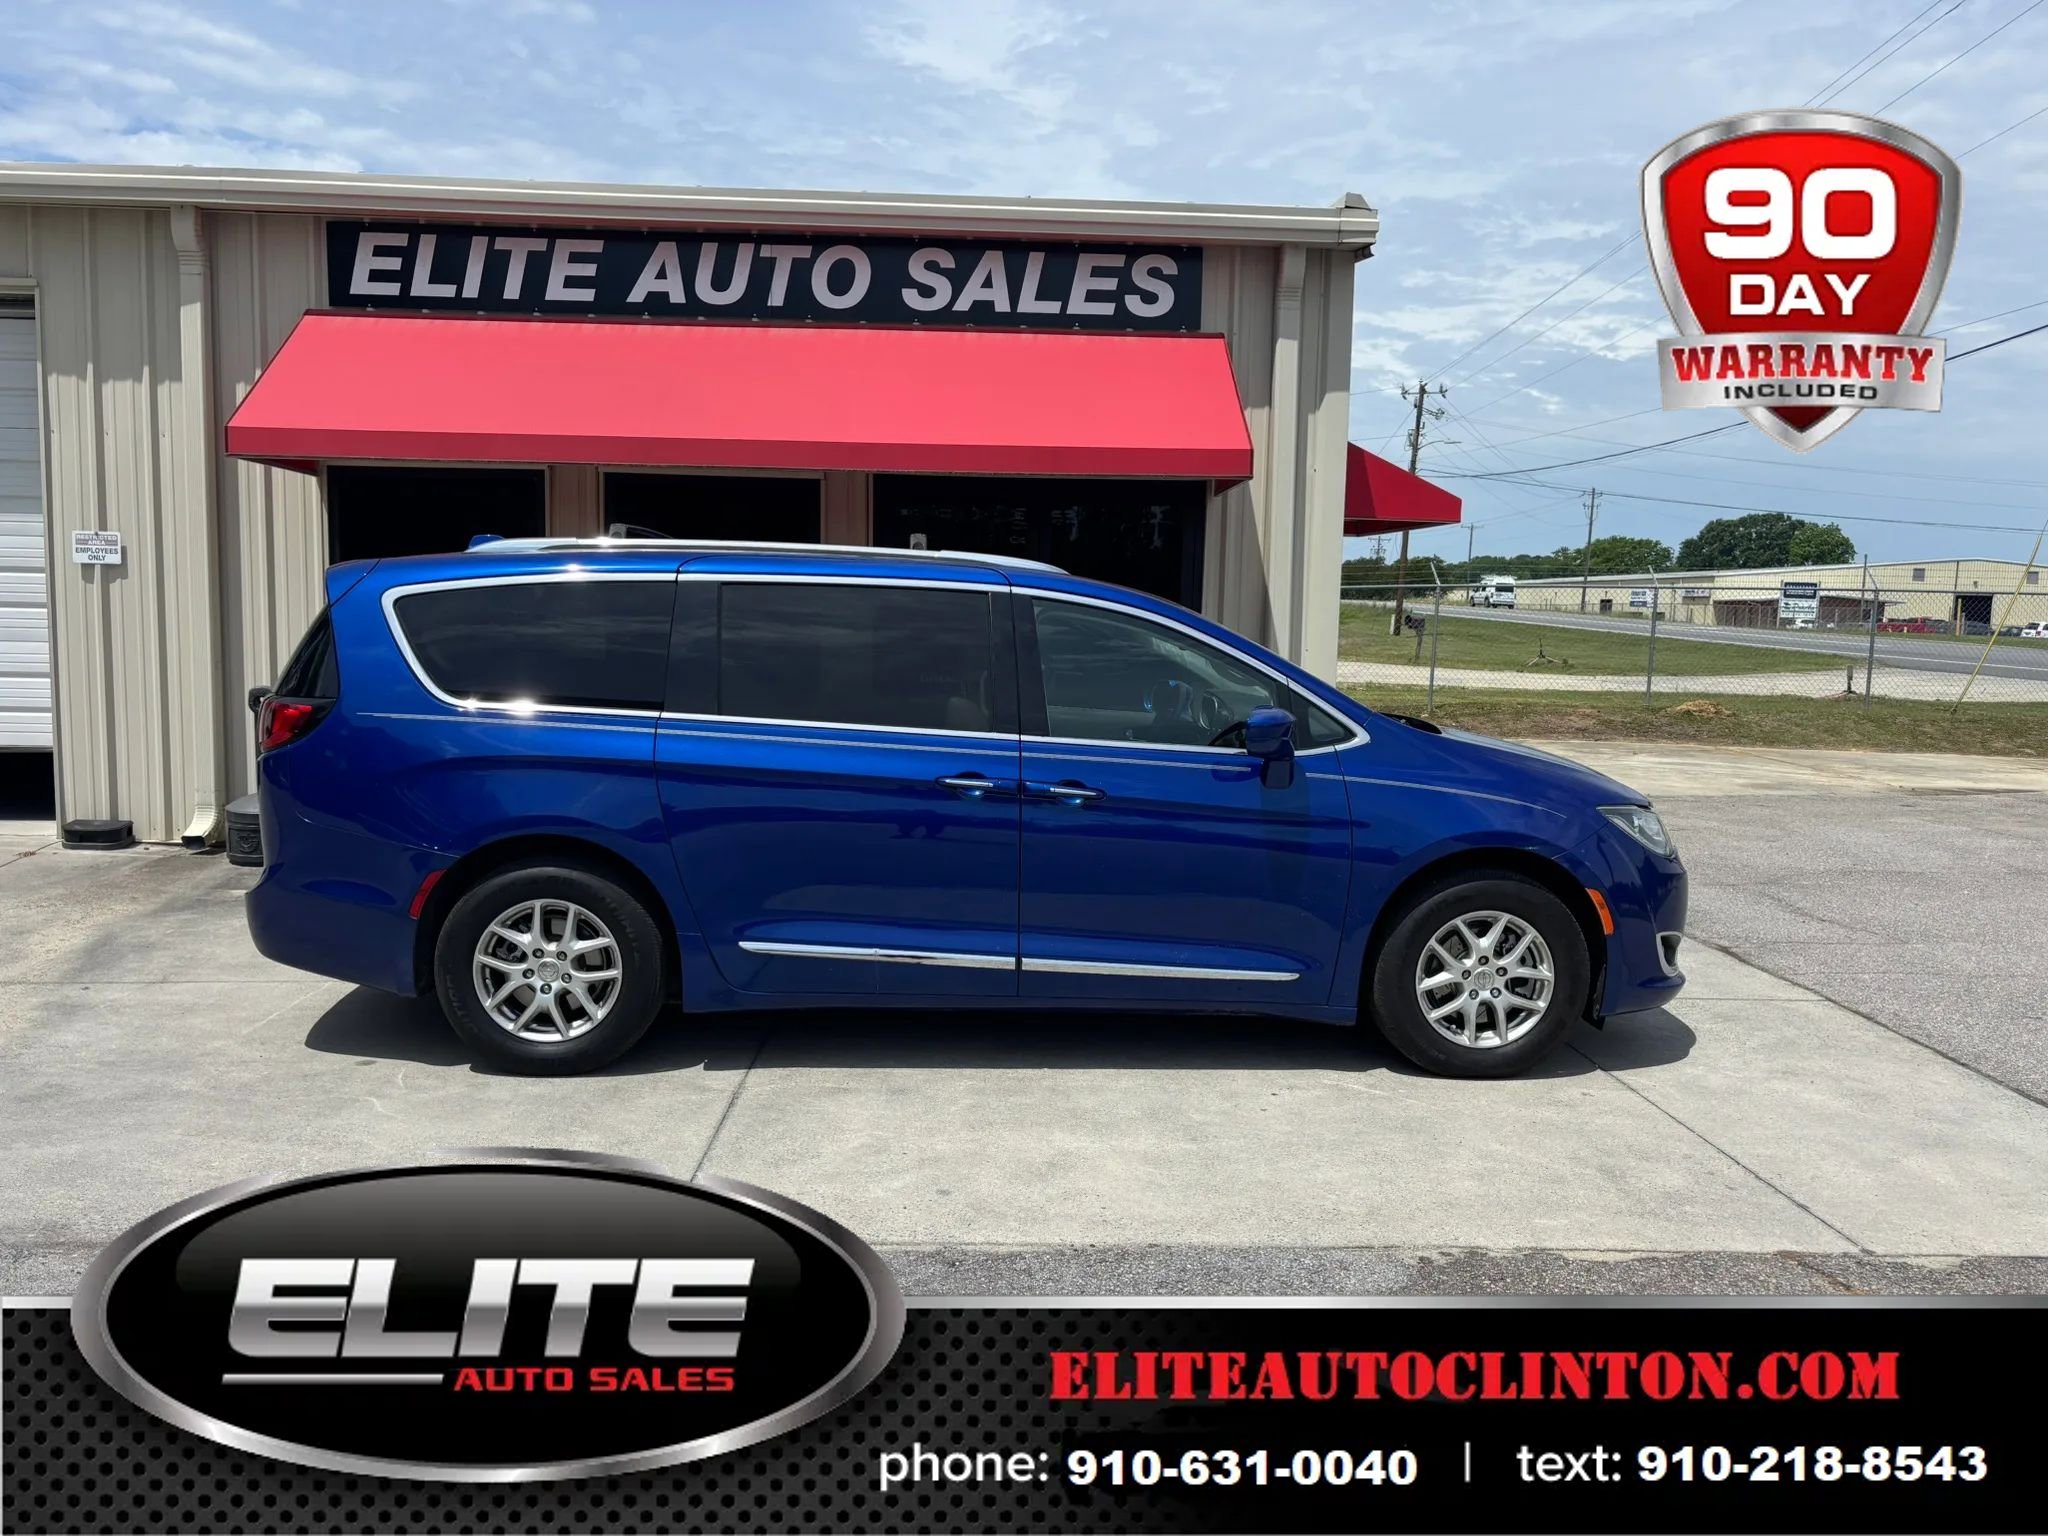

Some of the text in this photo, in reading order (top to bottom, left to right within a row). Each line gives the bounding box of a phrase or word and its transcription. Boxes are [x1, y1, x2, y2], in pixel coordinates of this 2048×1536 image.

[349, 232, 1179, 318] ELITE AUTO SALES
[75, 547, 119, 555] EMPLOYEES
